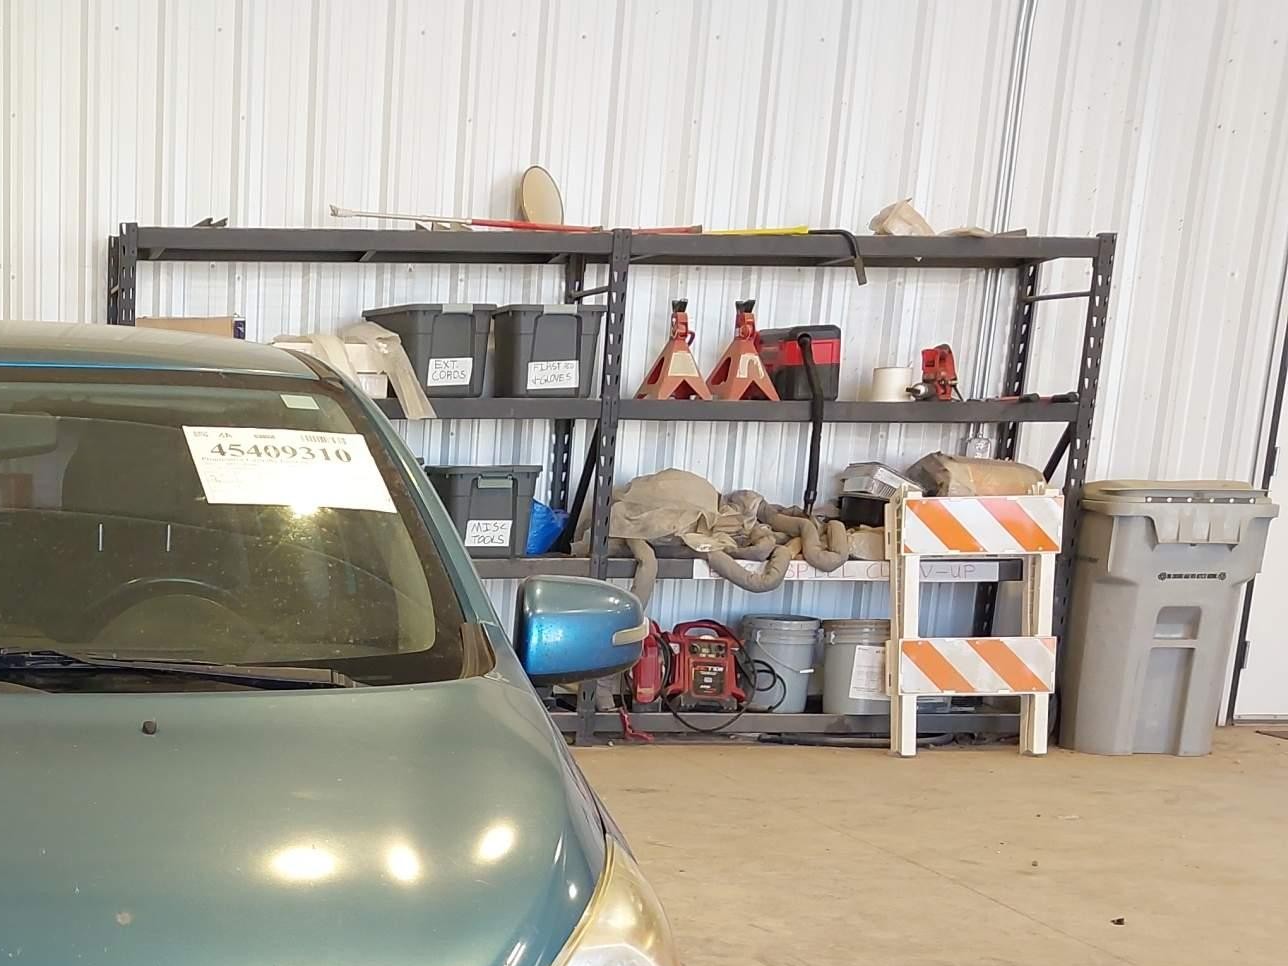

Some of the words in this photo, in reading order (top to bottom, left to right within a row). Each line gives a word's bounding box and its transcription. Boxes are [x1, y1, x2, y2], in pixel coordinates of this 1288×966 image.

[432, 369, 467, 381] CORDS
[210, 442, 352, 463] 45409310
[471, 534, 506, 545] TOOLS
